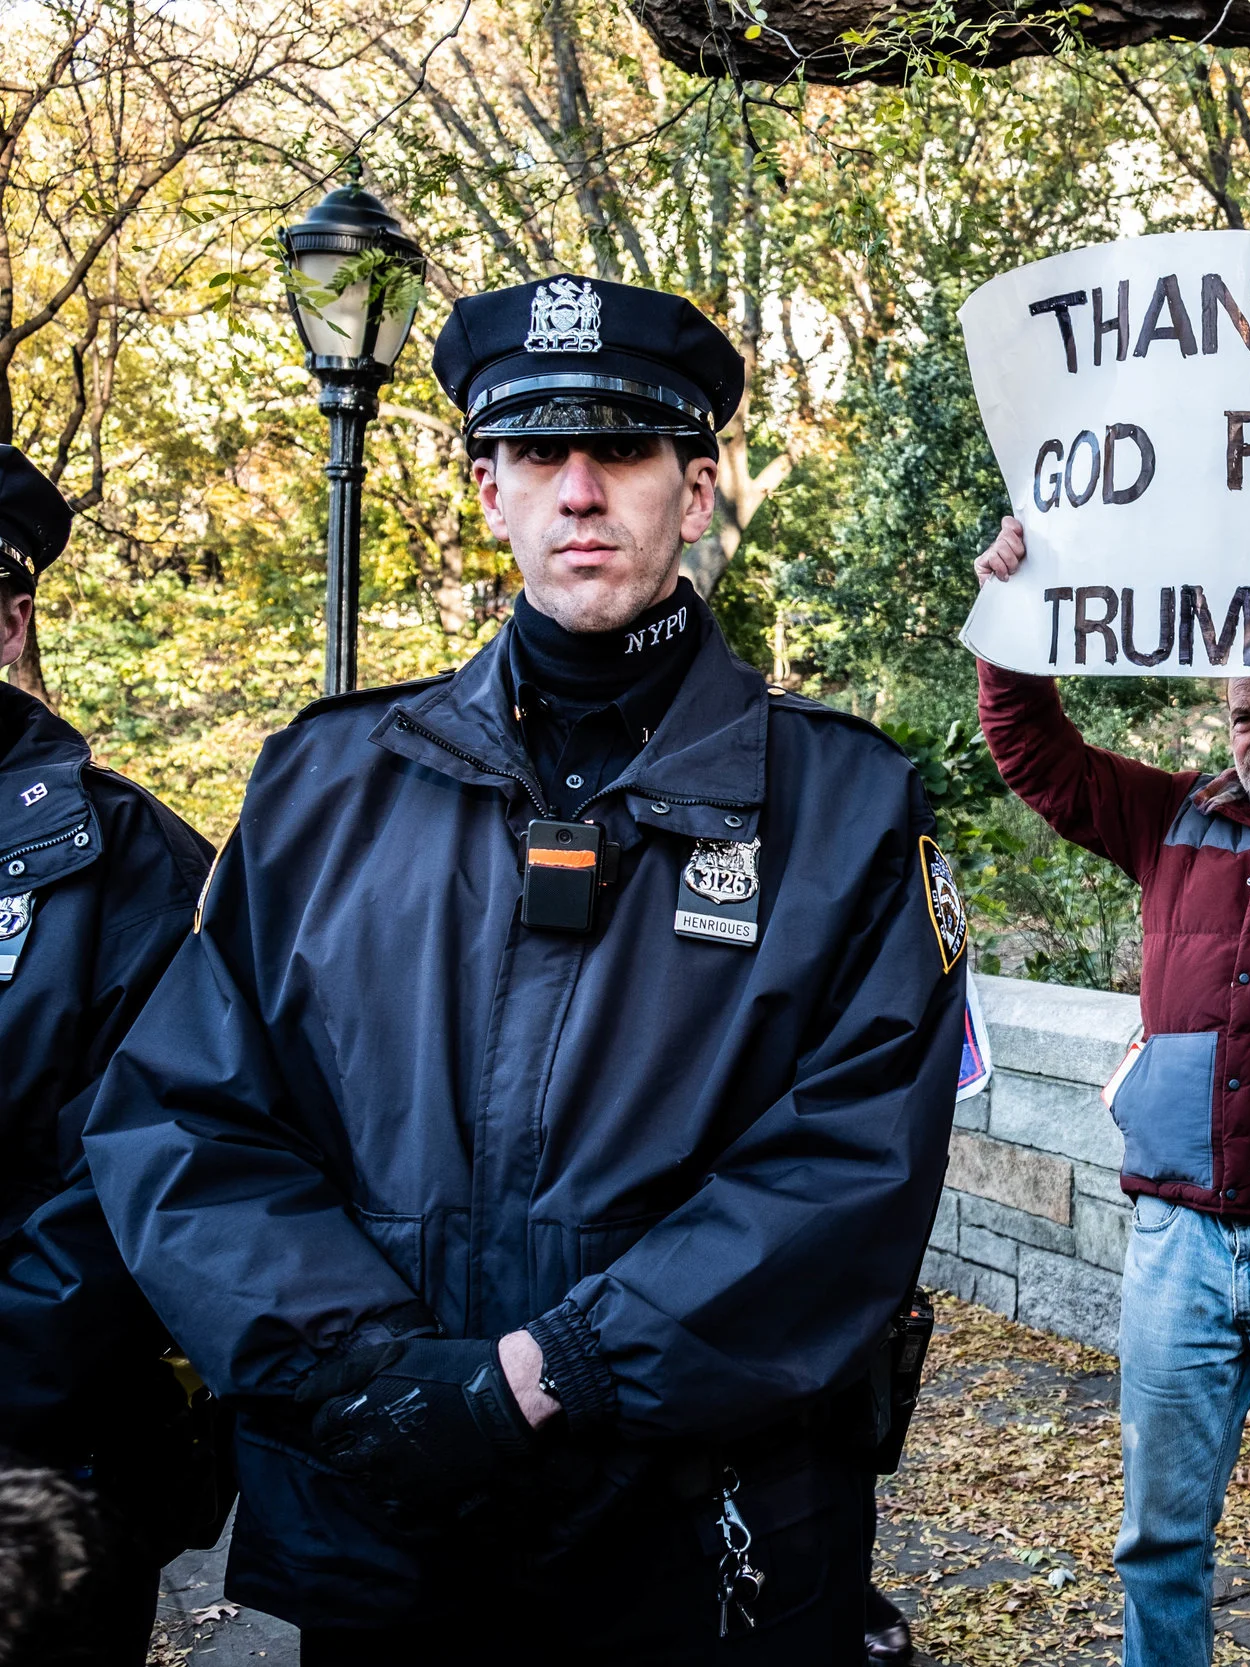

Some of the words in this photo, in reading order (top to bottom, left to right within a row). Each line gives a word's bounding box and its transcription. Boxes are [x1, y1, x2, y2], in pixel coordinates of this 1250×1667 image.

[533, 334, 594, 352] 3126
[1032, 422, 1156, 513] GOD
[624, 606, 687, 654] NYPD
[698, 867, 746, 896] 3126
[931, 889, 942, 918] CITY
[683, 915, 751, 937] HENRIQUES
